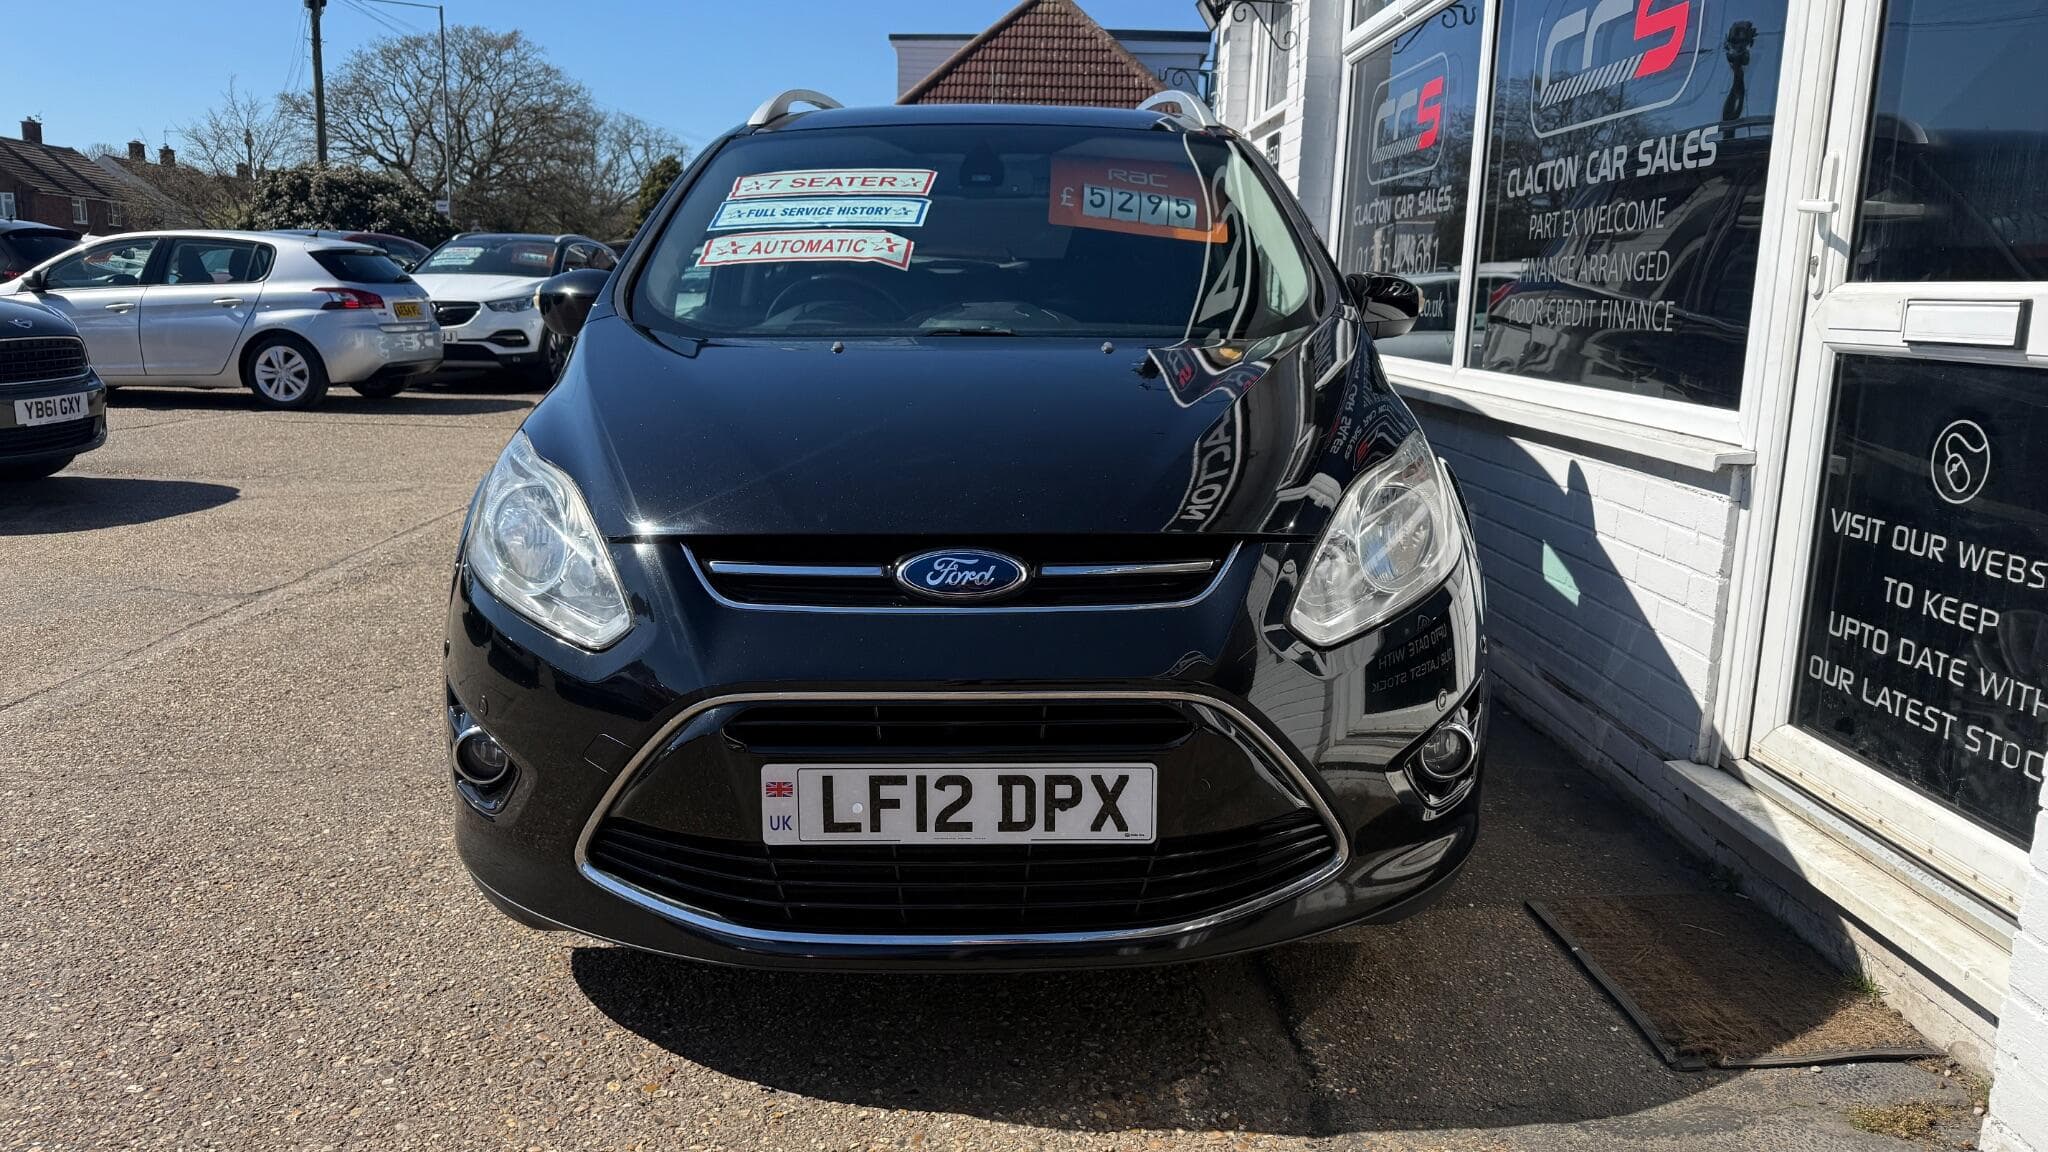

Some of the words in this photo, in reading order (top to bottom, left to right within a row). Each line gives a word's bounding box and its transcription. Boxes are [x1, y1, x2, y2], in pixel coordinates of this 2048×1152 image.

[1507, 154, 1579, 198] CLACTON
[1585, 144, 1628, 184] CAR
[1636, 125, 1719, 177] SALES
[768, 179, 782, 190] 7
[790, 176, 898, 189] SEATER
[746, 207, 777, 218] FULL
[780, 207, 834, 217] SERVICE
[837, 206, 892, 216] HISTORY
[1060, 187, 1075, 207] £
[1089, 187, 1192, 219] 5295
[1354, 197, 1391, 227] CLACTON
[1395, 194, 1415, 220] CAR
[1417, 185, 1453, 216] SALES
[1529, 210, 1561, 241] PART
[1562, 207, 1580, 238] EX
[1584, 197, 1667, 235] WELCOME
[748, 239, 867, 256] AUTOMATIC
[1519, 254, 1576, 284] FINANCE
[1577, 251, 1670, 283] ARRANGED
[1509, 299, 1544, 324] POOR
[1547, 299, 1597, 328] CREDIT
[1600, 300, 1676, 332] FINANCE
[24, 398, 58, 420] YB61
[60, 395, 81, 415] GXY
[1831, 508, 1886, 544] VISIT
[1892, 525, 1947, 563] OUR
[1959, 540, 2048, 589] WEBS
[926, 557, 997, 586] Ford
[1884, 576, 1914, 609] TO
[1922, 589, 2000, 634] KEEP
[1828, 610, 1889, 655] UPTO
[1897, 637, 1968, 687] DATE
[1808, 654, 1855, 695] OUR
[1862, 677, 1958, 740] LATEST
[822, 774, 973, 833] LF12
[997, 774, 1130, 833] DPX
[769, 815, 792, 831] UK
